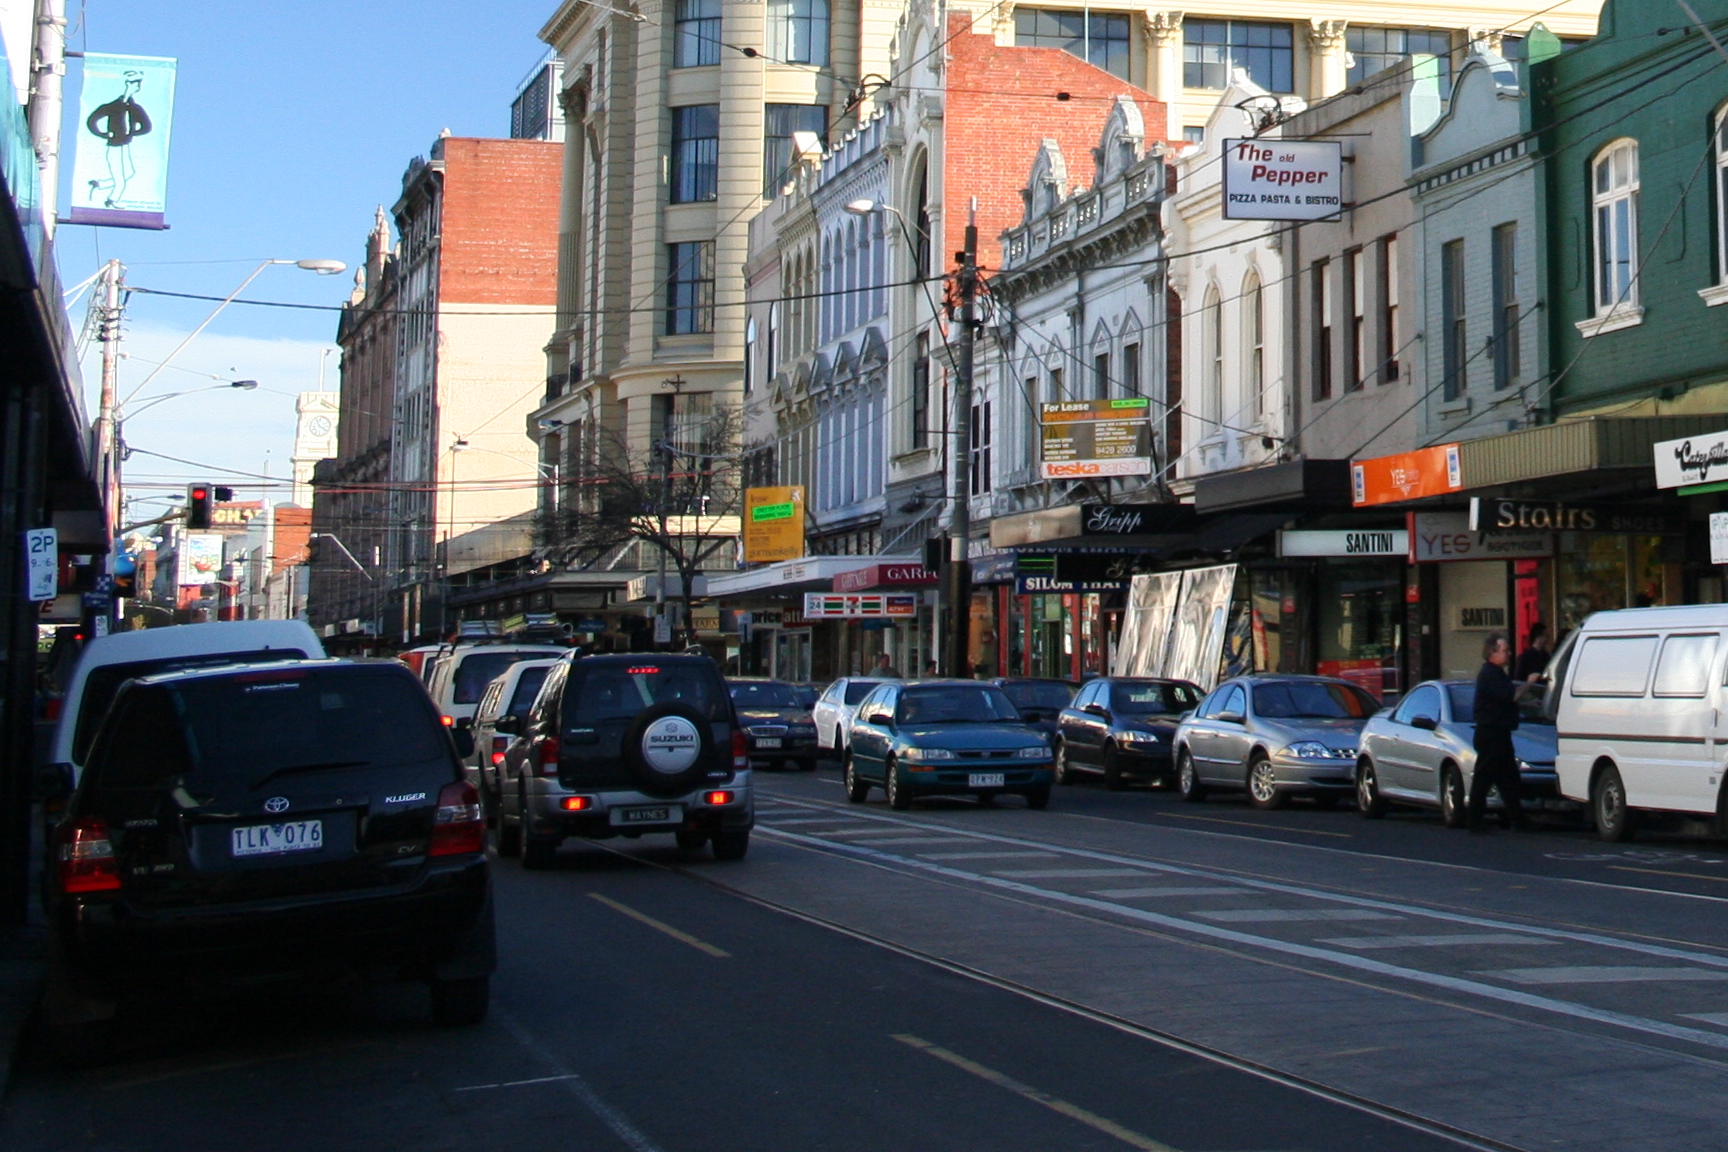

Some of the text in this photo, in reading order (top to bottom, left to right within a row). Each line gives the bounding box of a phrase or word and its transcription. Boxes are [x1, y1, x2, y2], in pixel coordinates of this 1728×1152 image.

[1238, 144, 1295, 162] The old
[1251, 165, 1328, 187] Pepper
[1230, 194, 1257, 203] PIZZA
[1261, 194, 1290, 204] PASTA
[1305, 196, 1339, 205] BISTRO
[1043, 403, 1089, 412] For Lease
[1046, 462, 1100, 476] teska
[1087, 505, 1142, 533] Gripp
[1497, 502, 1596, 529] Stairs
[1612, 516, 1666, 529] SHOES
[31, 536, 54, 553] 2P
[1346, 534, 1393, 553] SANTINI
[1422, 534, 1470, 554] YES
[752, 610, 782, 623] price
[1462, 608, 1504, 627] SANTINI
[651, 735, 693, 743] SUZUKI
[386, 792, 425, 804] KLUGER
[235, 823, 320, 848] TLK 076
